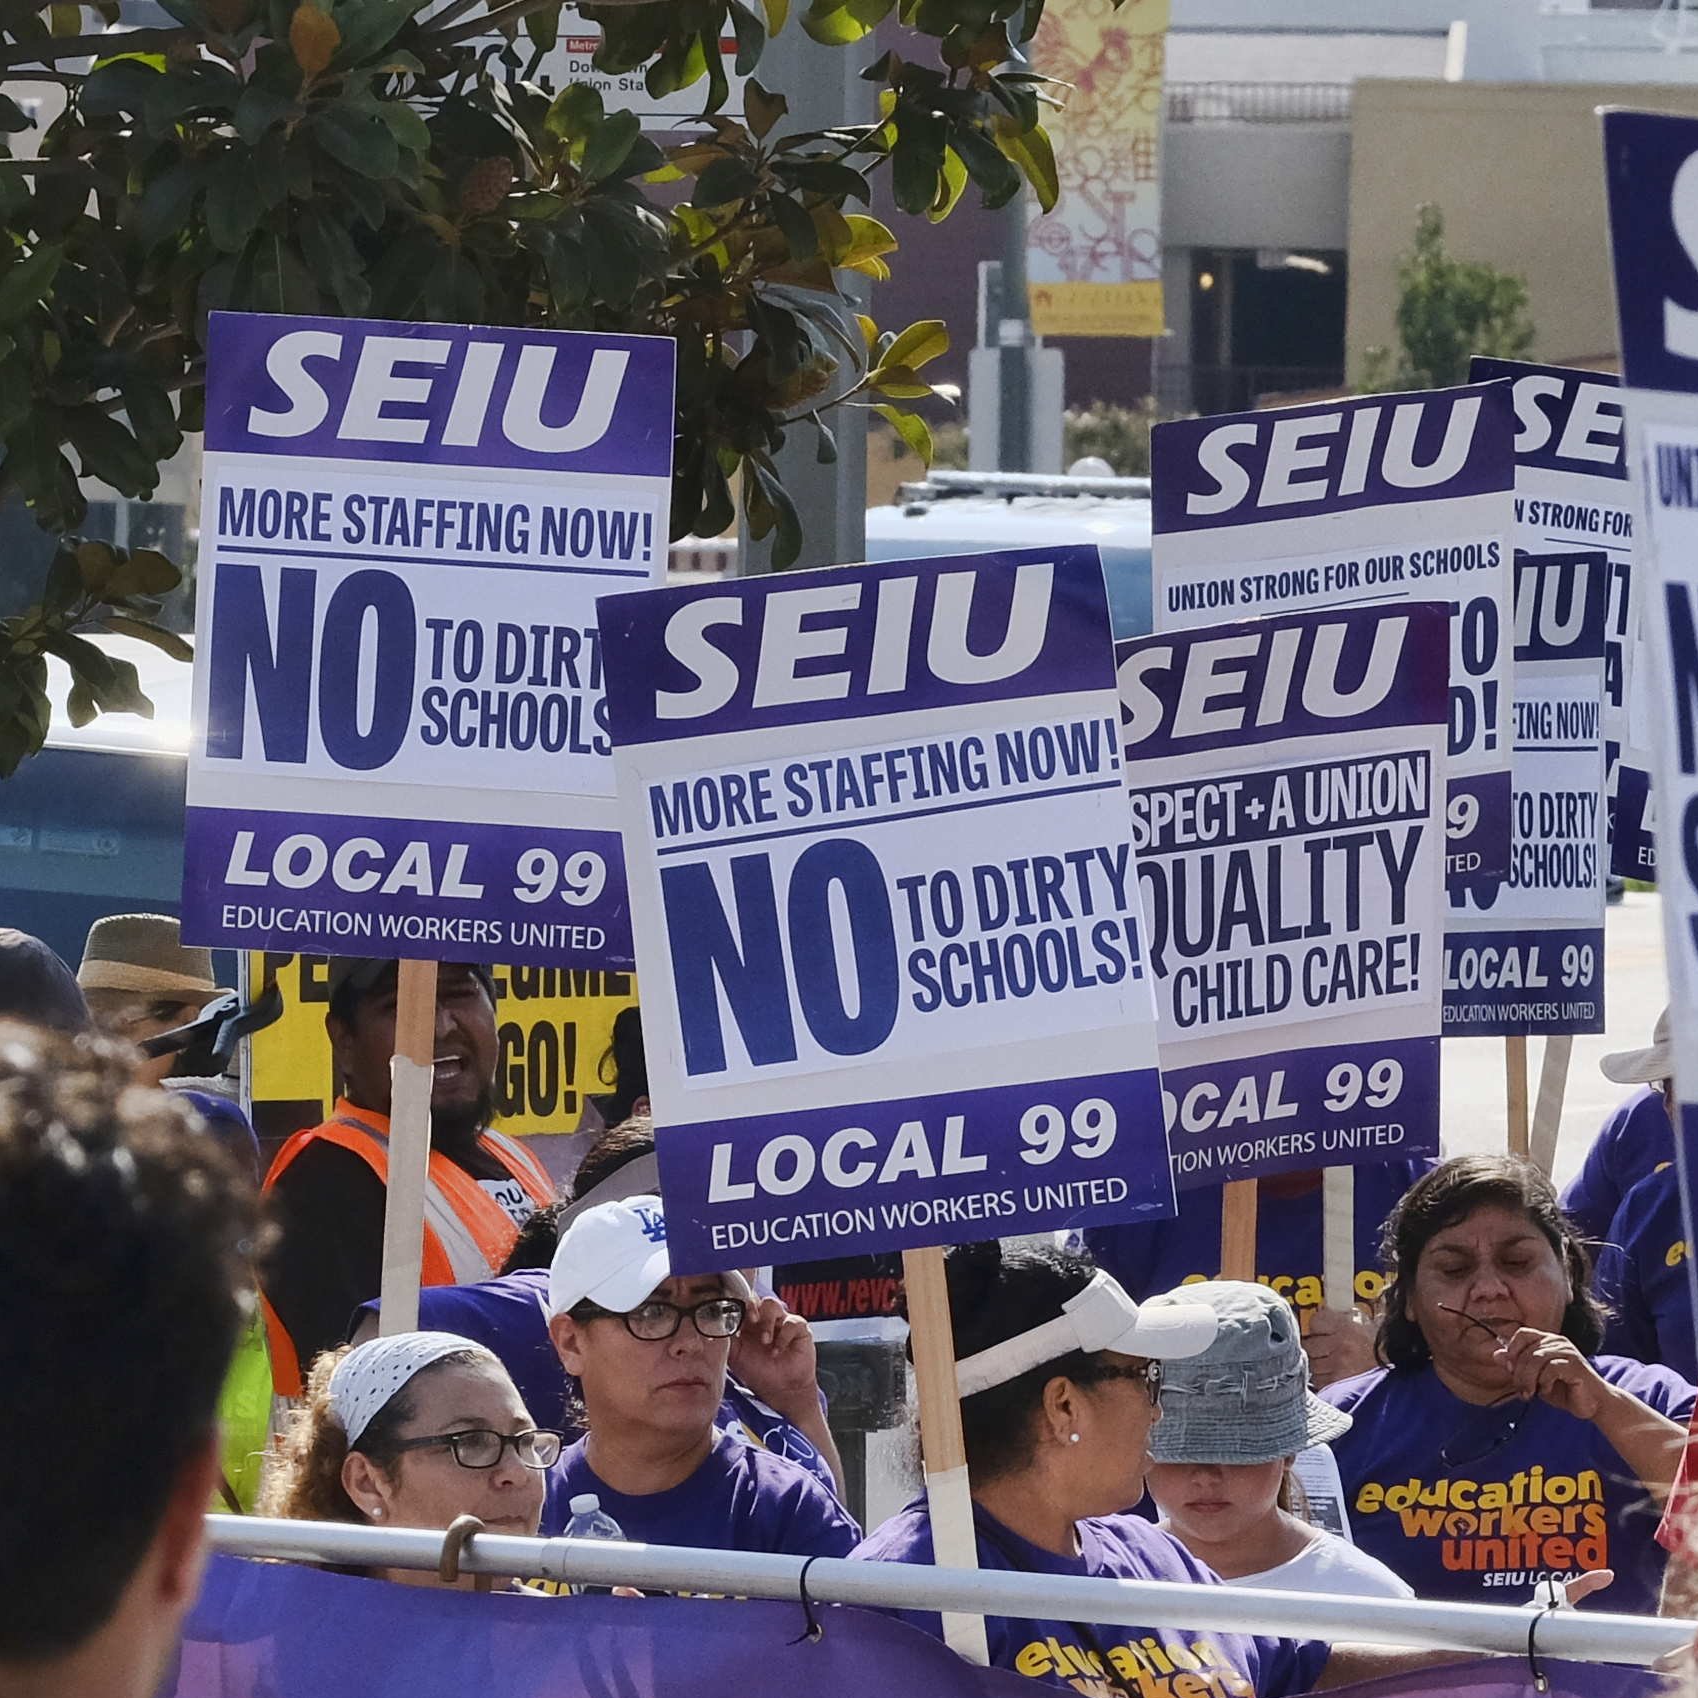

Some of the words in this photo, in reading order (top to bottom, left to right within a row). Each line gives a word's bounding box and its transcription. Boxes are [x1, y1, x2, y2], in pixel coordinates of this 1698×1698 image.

[247, 331, 631, 453] SEIU
[1186, 396, 1483, 515] SEIU
[218, 487, 332, 542] MORE
[342, 494, 530, 554] STAFFING
[540, 506, 653, 561] NOW!
[1528, 499, 1600, 536] STRONG
[1602, 509, 1632, 537] FOR
[1167, 581, 1235, 613] UNION
[1240, 565, 1320, 603] STRONG
[1323, 560, 1360, 593] FOR
[1364, 557, 1405, 587] OUR
[1409, 542, 1500, 579] SCHOOLS
[206, 564, 417, 770] NO
[425, 618, 482, 683] TO
[496, 623, 606, 689] DIRT
[655, 563, 1055, 720] SEIU
[1117, 616, 1409, 747] SEIU
[1555, 701, 1600, 739] NOW!
[649, 769, 778, 839] MORE
[784, 737, 988, 817] STAFFING
[996, 717, 1121, 785] NOW!
[1268, 776, 1296, 843] A
[1304, 756, 1426, 827] UNION
[1539, 792, 1598, 837] DIRTY
[224, 831, 485, 899] LOCAL
[513, 847, 607, 906] 99
[897, 868, 964, 942] TO
[972, 843, 1130, 930] DIRTY
[1137, 824, 1424, 979] QUALITY
[1510, 843, 1597, 889] SCHOOLS!
[222, 905, 372, 937] EDUCATION
[378, 915, 502, 944] WORKERS
[510, 923, 606, 950] UNITED
[660, 838, 901, 1077] NO
[908, 916, 1144, 1013] SCHOOLS!
[1172, 954, 1292, 1029] CHILD
[1302, 933, 1420, 1007] CARE!
[1443, 949, 1549, 991] LOCAL
[1560, 944, 1594, 987] 99
[1442, 1003, 1496, 1023] EDUCATION
[1497, 1003, 1556, 1021] WORKERS
[1558, 1002, 1595, 1020] UNITED
[497, 1022, 577, 1117] GO!
[1323, 1058, 1404, 1113] 99
[708, 1116, 988, 1203] LOCAL
[1019, 1098, 1117, 1166] 99
[1217, 1133, 1315, 1171] WORKERS
[1321, 1123, 1405, 1150] UNITED
[711, 1207, 876, 1250] EDUCATION
[881, 1190, 1017, 1230] WORKERS
[1023, 1177, 1127, 1214] UNITED
[780, 1277, 905, 1315] www.revc
[1356, 1465, 1603, 1513] education
[1400, 1500, 1605, 1537] workers
[1442, 1529, 1607, 1571] united
[1483, 1571, 1525, 1587] SEIU
